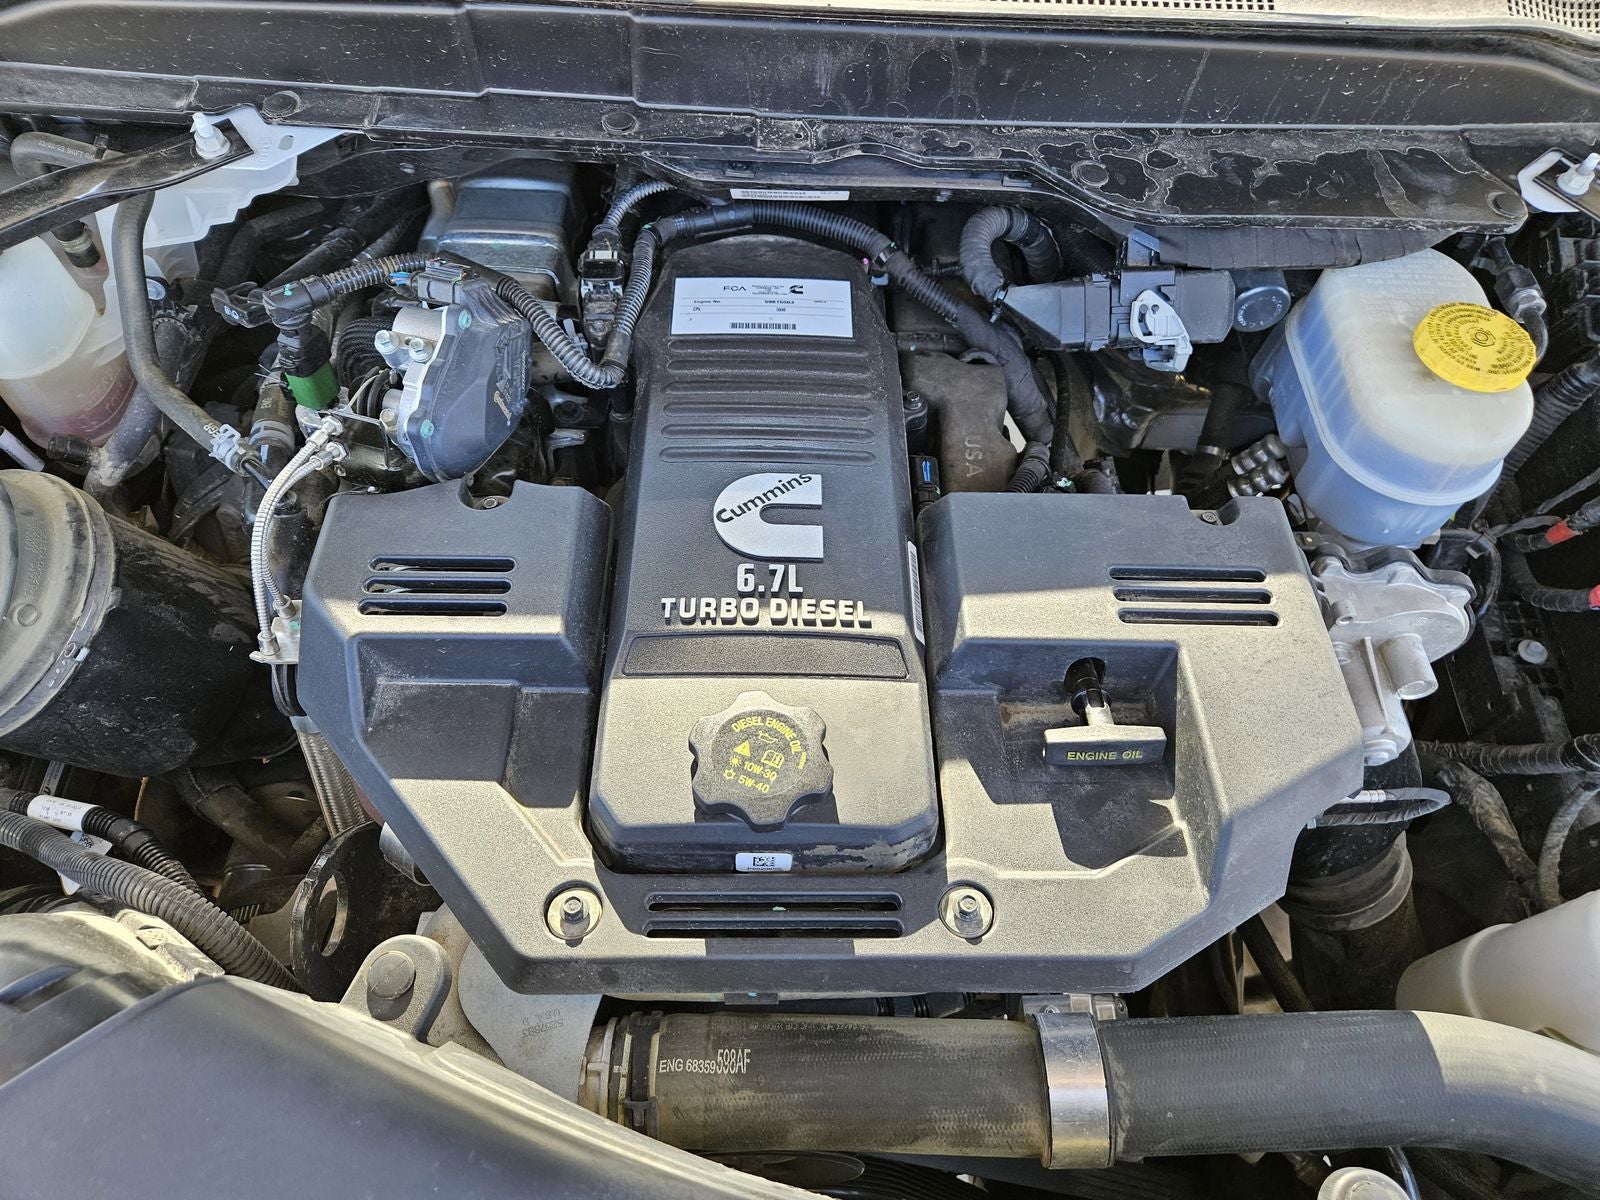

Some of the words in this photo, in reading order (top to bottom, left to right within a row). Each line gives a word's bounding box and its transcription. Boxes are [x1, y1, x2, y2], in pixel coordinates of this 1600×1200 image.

[715, 473, 813, 523] Cummins
[736, 563, 804, 597] 6.7L
[661, 597, 760, 624] TURBO
[769, 598, 872, 627] DIESEL
[731, 716, 764, 733] DIESEL
[765, 717, 798, 740] ENGINE
[789, 740, 803, 754] OIL
[1067, 751, 1117, 761] ENGINE
[1121, 750, 1143, 759] OIL
[743, 760, 778, 781] 10W-30
[738, 774, 770, 793] 5W-40
[659, 1058, 683, 1073] ENG
